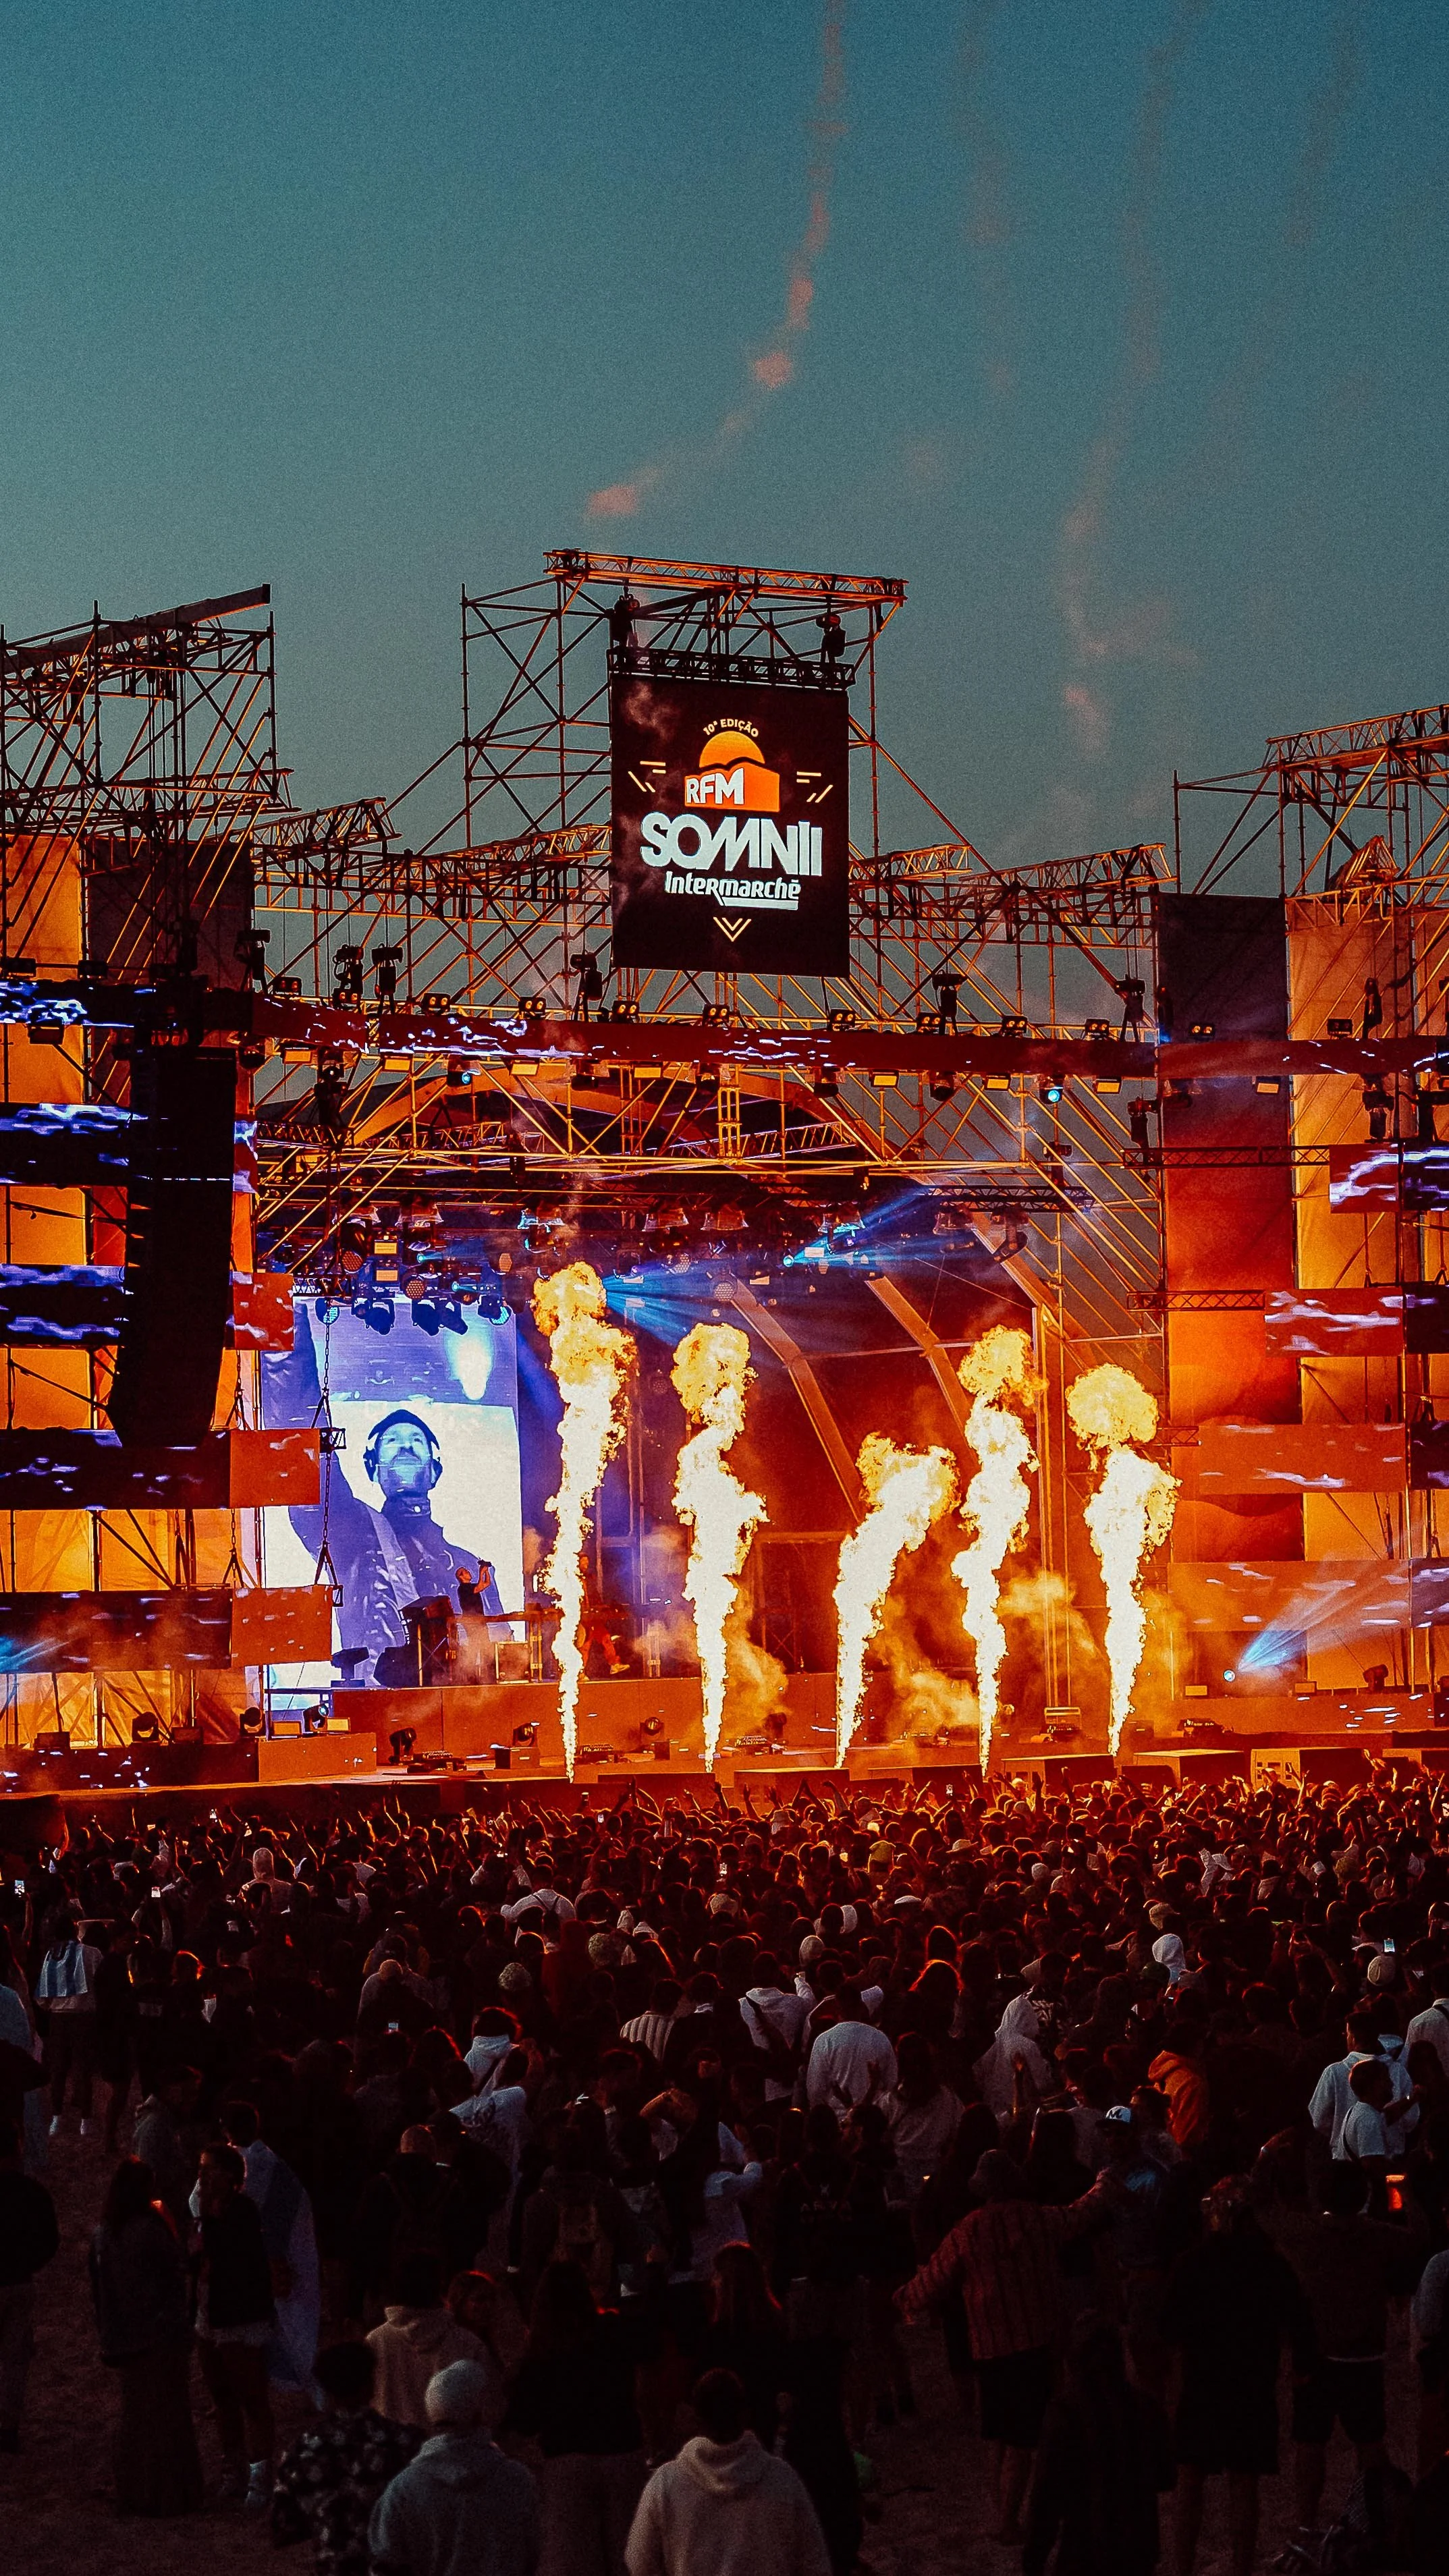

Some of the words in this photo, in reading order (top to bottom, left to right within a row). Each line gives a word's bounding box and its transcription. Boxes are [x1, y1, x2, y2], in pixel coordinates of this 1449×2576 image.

[720, 718, 759, 737] EDIÇÃO
[686, 768, 744, 805] RFM
[640, 812, 822, 877] SOMNII
